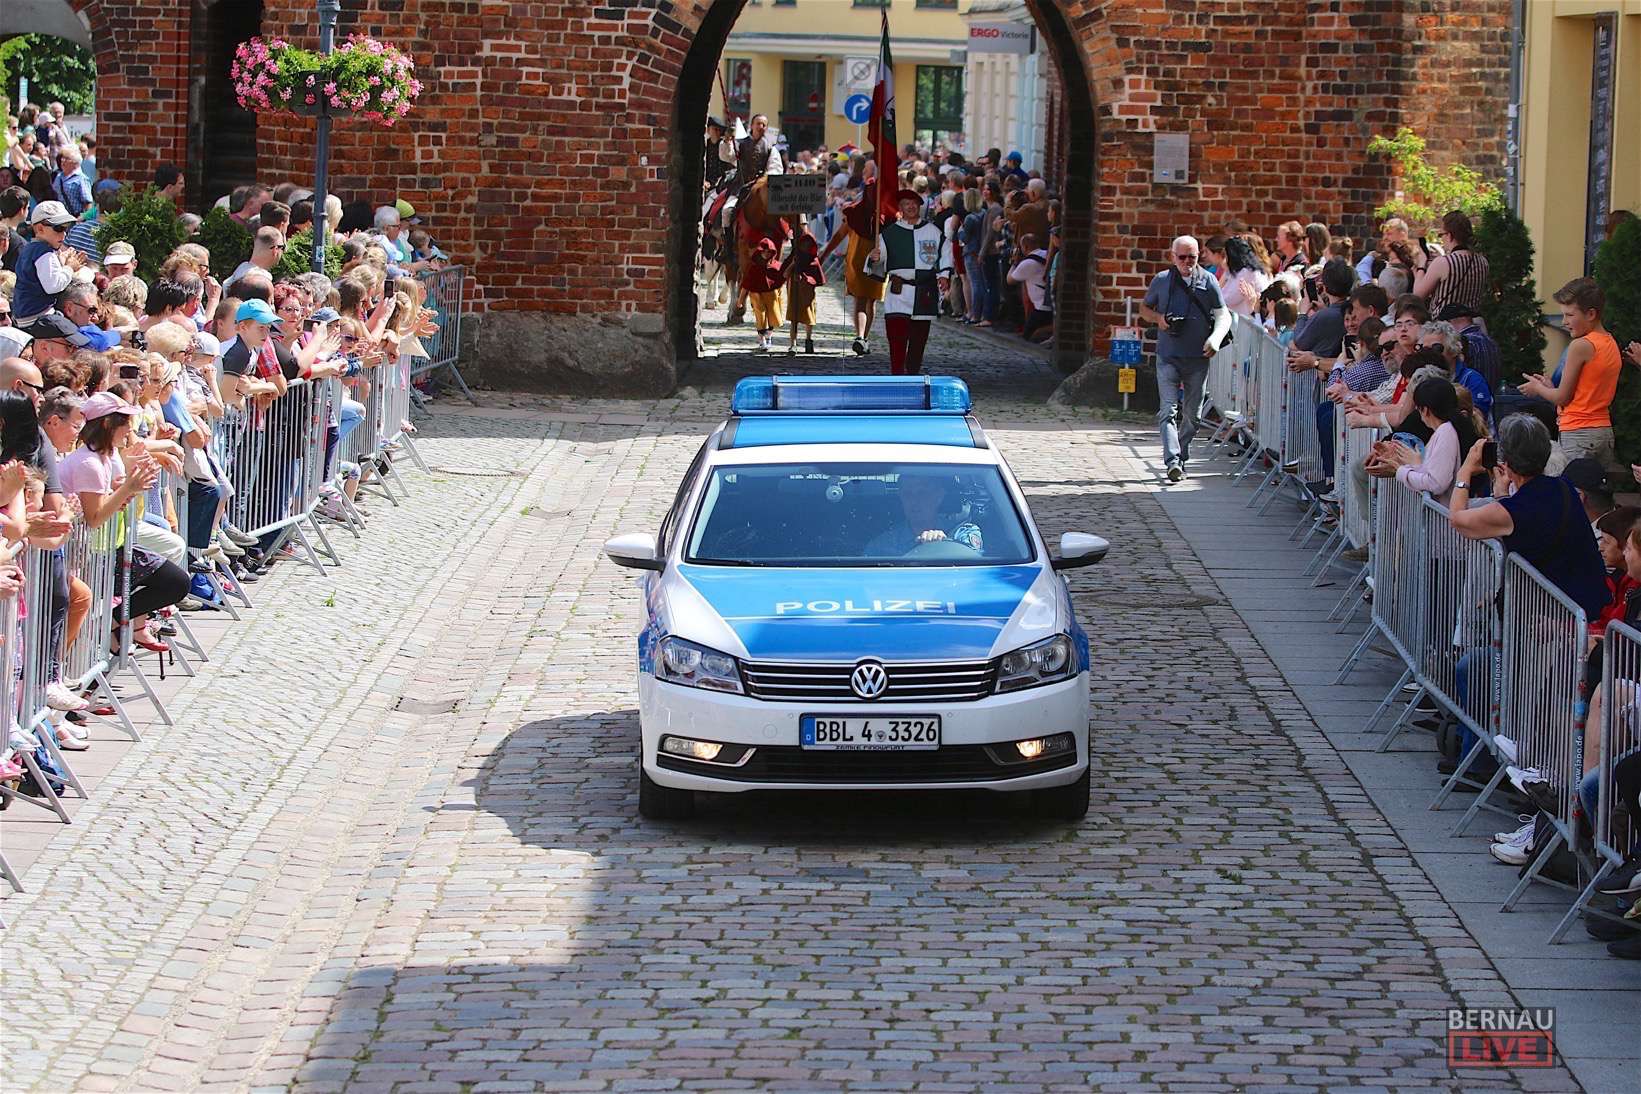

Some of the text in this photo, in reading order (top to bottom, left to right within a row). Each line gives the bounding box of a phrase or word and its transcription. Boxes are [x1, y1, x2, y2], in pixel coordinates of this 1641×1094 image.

[970, 27, 999, 38] ERGO
[775, 599, 957, 615] POLIZEI
[815, 720, 937, 742] BBL 4 3326
